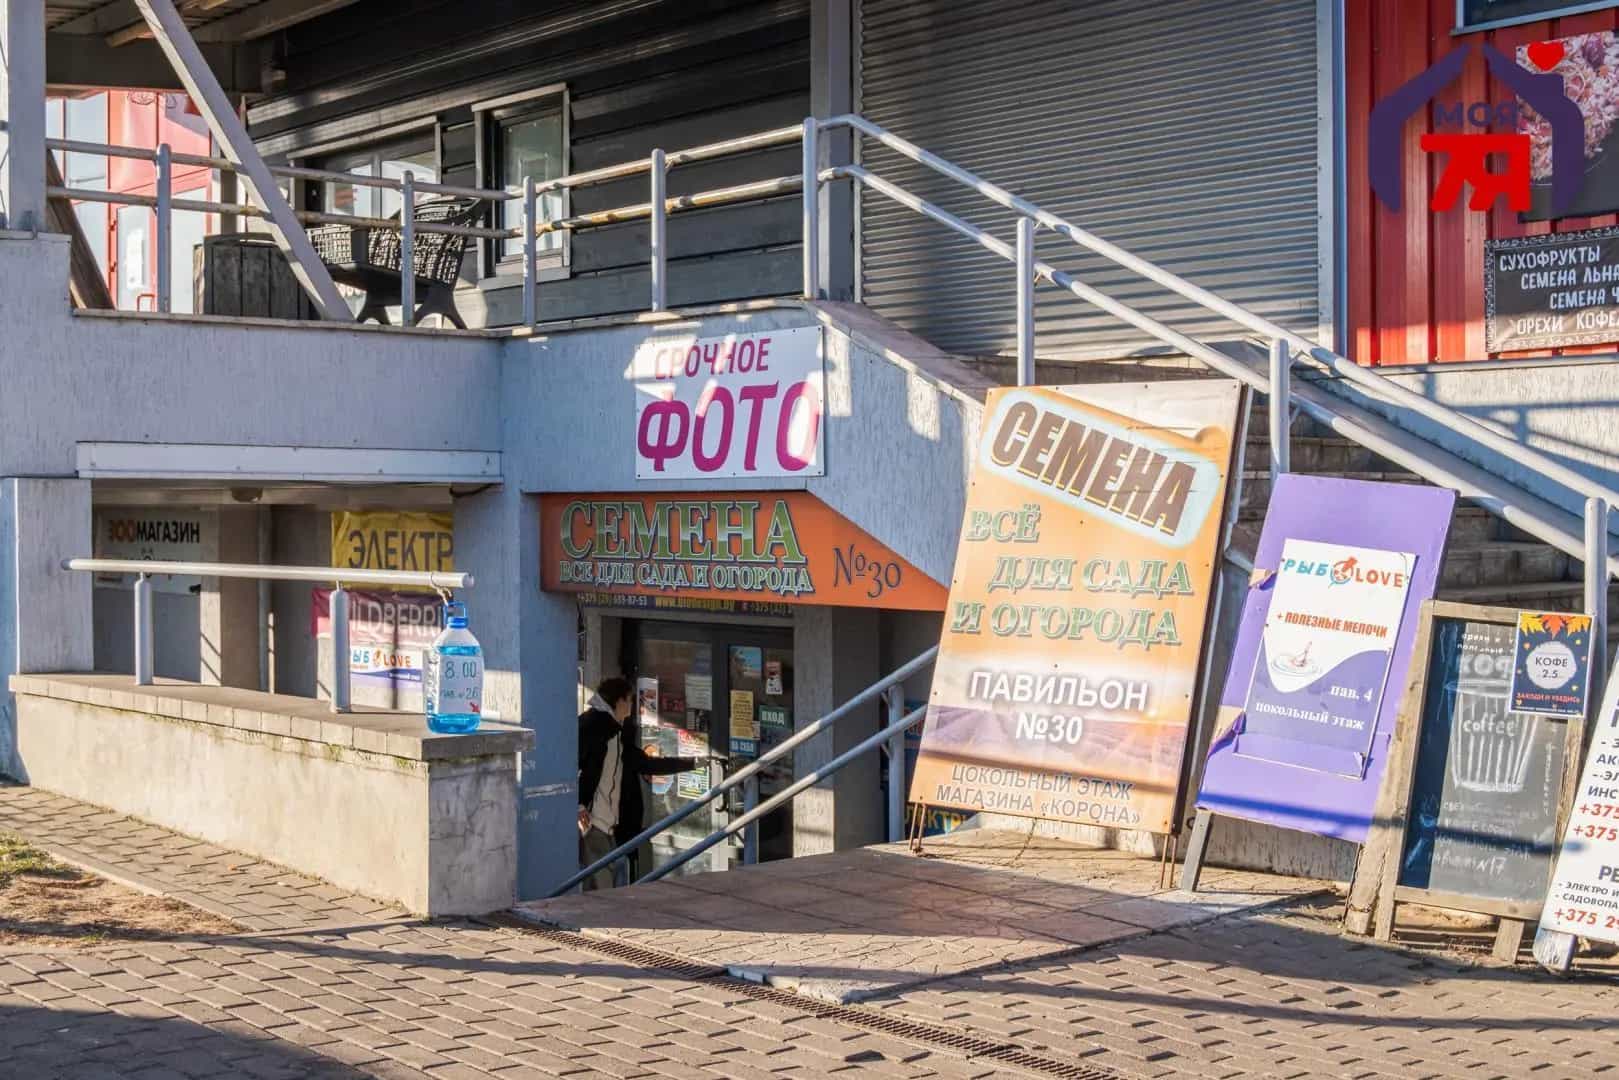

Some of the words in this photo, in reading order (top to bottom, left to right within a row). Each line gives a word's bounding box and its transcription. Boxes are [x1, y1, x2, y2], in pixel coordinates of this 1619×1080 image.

[1499, 245, 1601, 272] СУХОФРУКТЫ
[1521, 269, 1577, 290] СЕМЕНА
[1549, 288, 1605, 309] СЕМЕНА
[1516, 315, 1563, 335] ОРЕХИ
[1576, 310, 1619, 330] КОФЕ
[655, 338, 772, 380] СРОЧНОЕ
[637, 380, 820, 472] ФОТО
[990, 400, 1197, 536] СЕМЕНА
[559, 500, 807, 564] СЕМЕНА
[966, 504, 1041, 542] ВСЁ
[348, 530, 454, 571] ЭЛЕКТР
[559, 561, 593, 583] ВСЕ
[594, 562, 635, 587] ДЛЯ
[636, 563, 690, 590] САДА
[692, 565, 709, 588] И
[712, 566, 815, 596] ОГОРОДА
[833, 543, 901, 599] №30
[988, 556, 1076, 594] ДЛЯ
[1082, 559, 1195, 598] САДА
[352, 600, 443, 637] ILDBERRI
[951, 601, 982, 634] И
[991, 603, 1182, 651] ОГОРОДА
[1285, 611, 1341, 631] ПОЛЕЗНЫЕ
[1343, 619, 1389, 638] МЕЛОЧИ
[1535, 657, 1568, 668] КОФЕ
[968, 670, 1150, 711] ПАВИЛЬОН
[1365, 688, 1374, 701] 4
[1015, 711, 1083, 745] №30
[1255, 701, 1329, 724] цокольный
[1331, 713, 1366, 731] этаж
[1596, 754, 1619, 766] АК
[952, 764, 1072, 794] ЦОКОЛЬНЫЙ
[1080, 778, 1135, 800] ЭТАЖ
[936, 785, 1034, 813] МАГАЗИНА
[1040, 797, 1141, 824] «КОРОНА»
[1573, 824, 1618, 841] +375
[1565, 881, 1609, 895] ЭЛЕКТРО
[1554, 908, 1598, 926] +375
